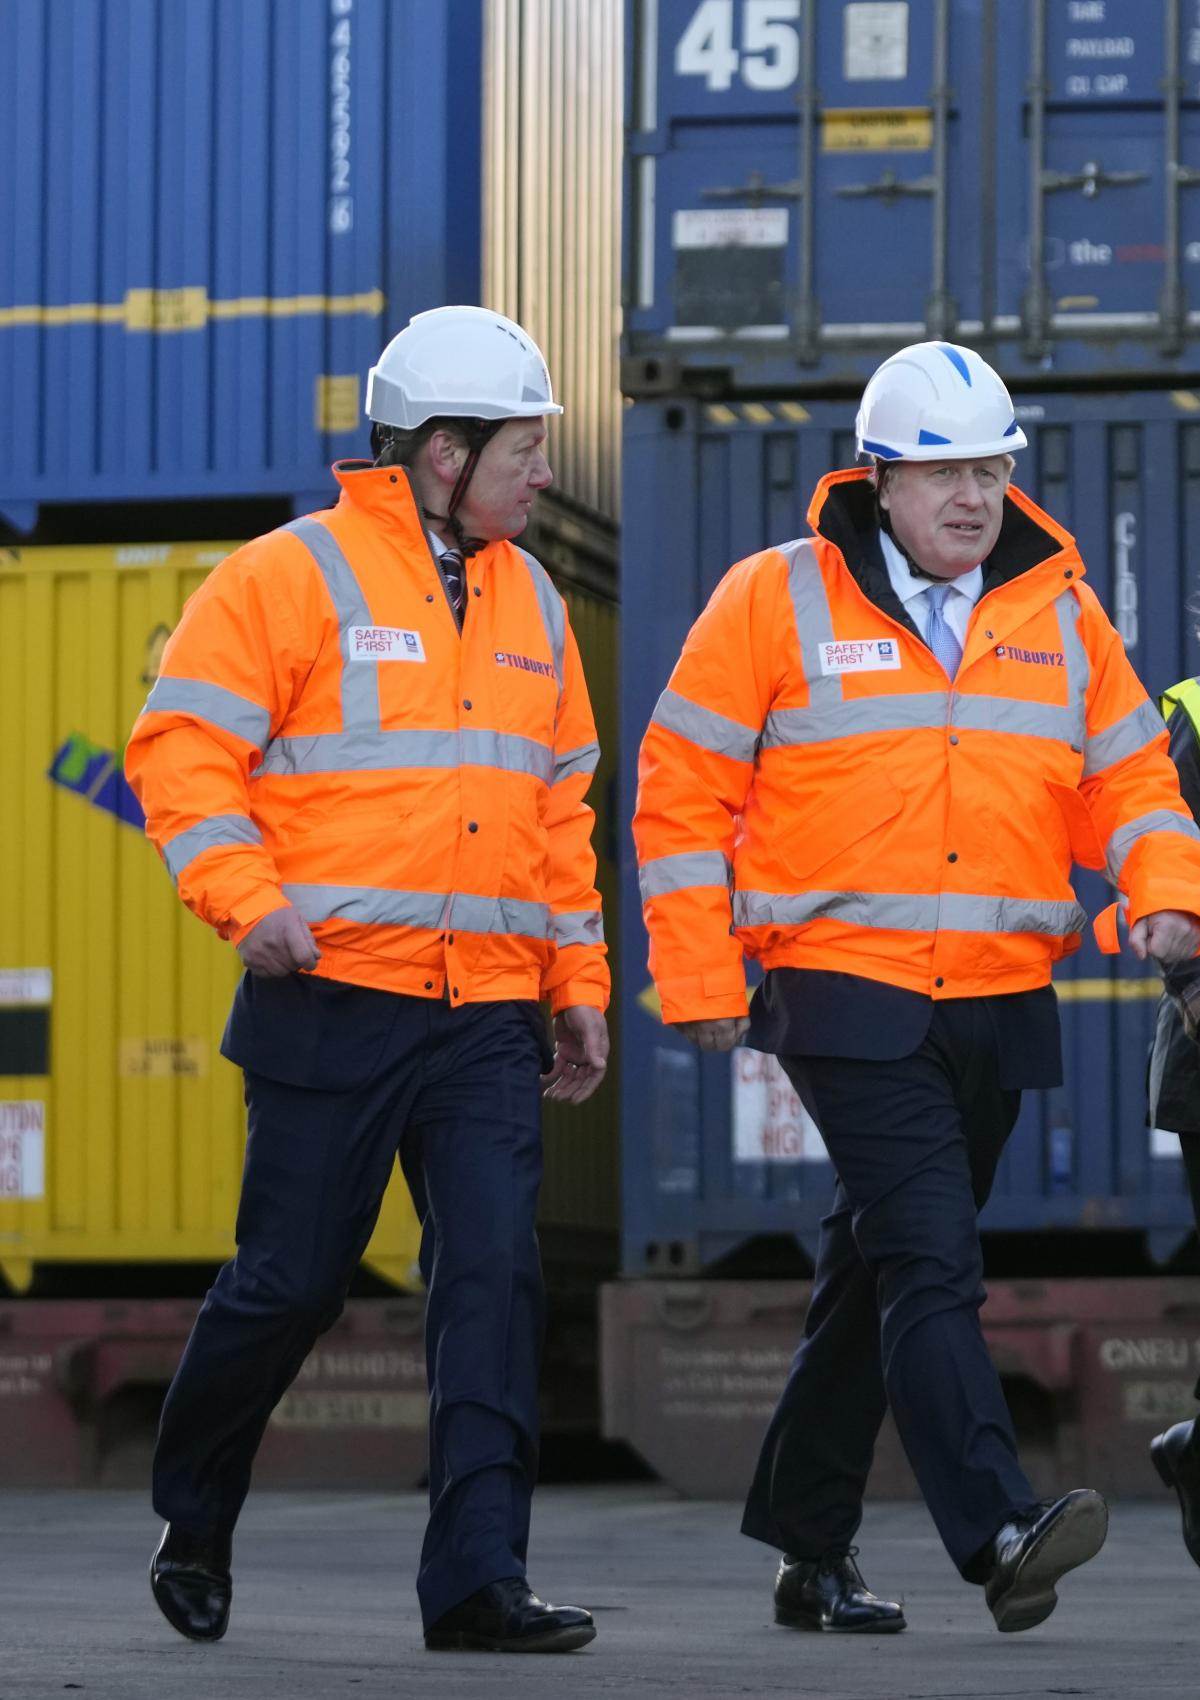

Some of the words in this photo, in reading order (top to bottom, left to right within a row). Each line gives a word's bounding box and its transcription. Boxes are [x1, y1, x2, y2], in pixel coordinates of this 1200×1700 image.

[675, 0, 799, 89] 45
[1069, 238, 1112, 264] the
[355, 629, 401, 641] SAFETY
[825, 642, 874, 656] SAFETY
[1007, 645, 1065, 667] TILBURY2
